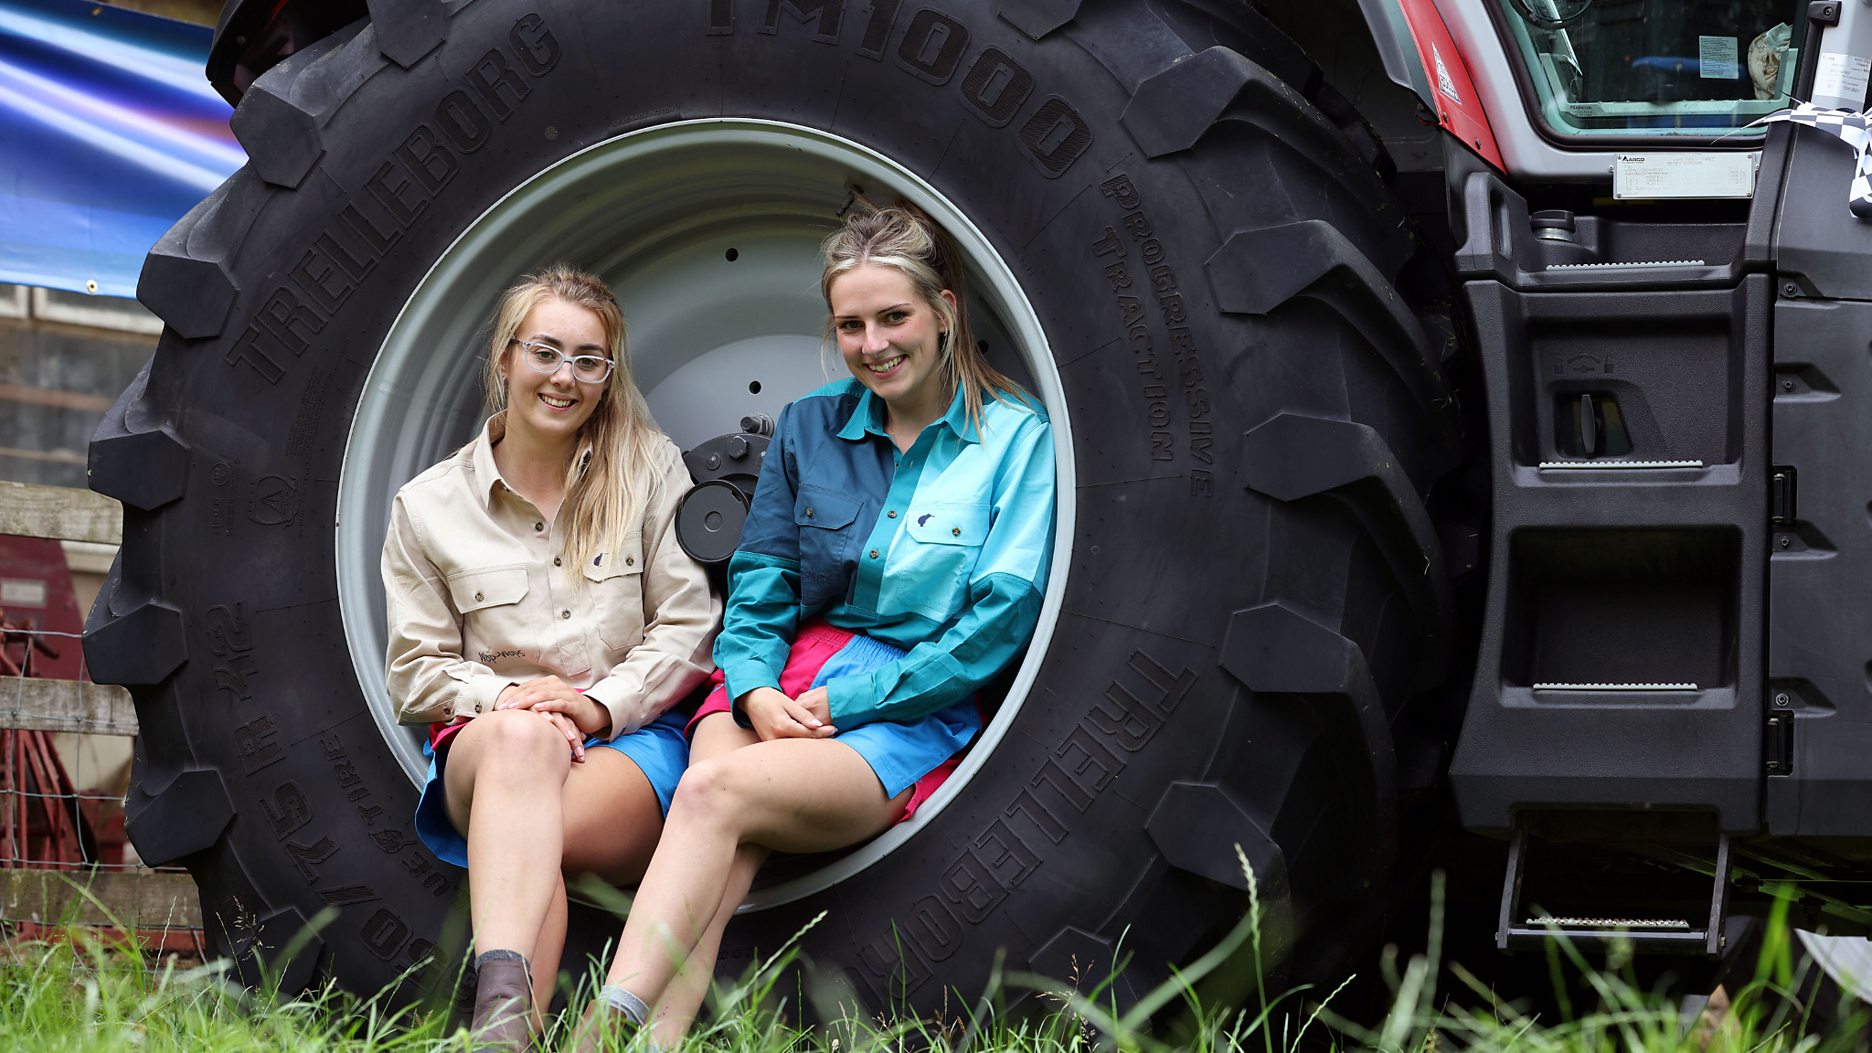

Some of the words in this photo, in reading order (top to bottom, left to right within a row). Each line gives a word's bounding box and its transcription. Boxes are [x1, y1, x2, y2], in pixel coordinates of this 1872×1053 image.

[225, 12, 561, 385] TRELLEBORG
[206, 600, 260, 702] 42
[234, 713, 287, 777] R
[319, 734, 386, 826] TIRE
